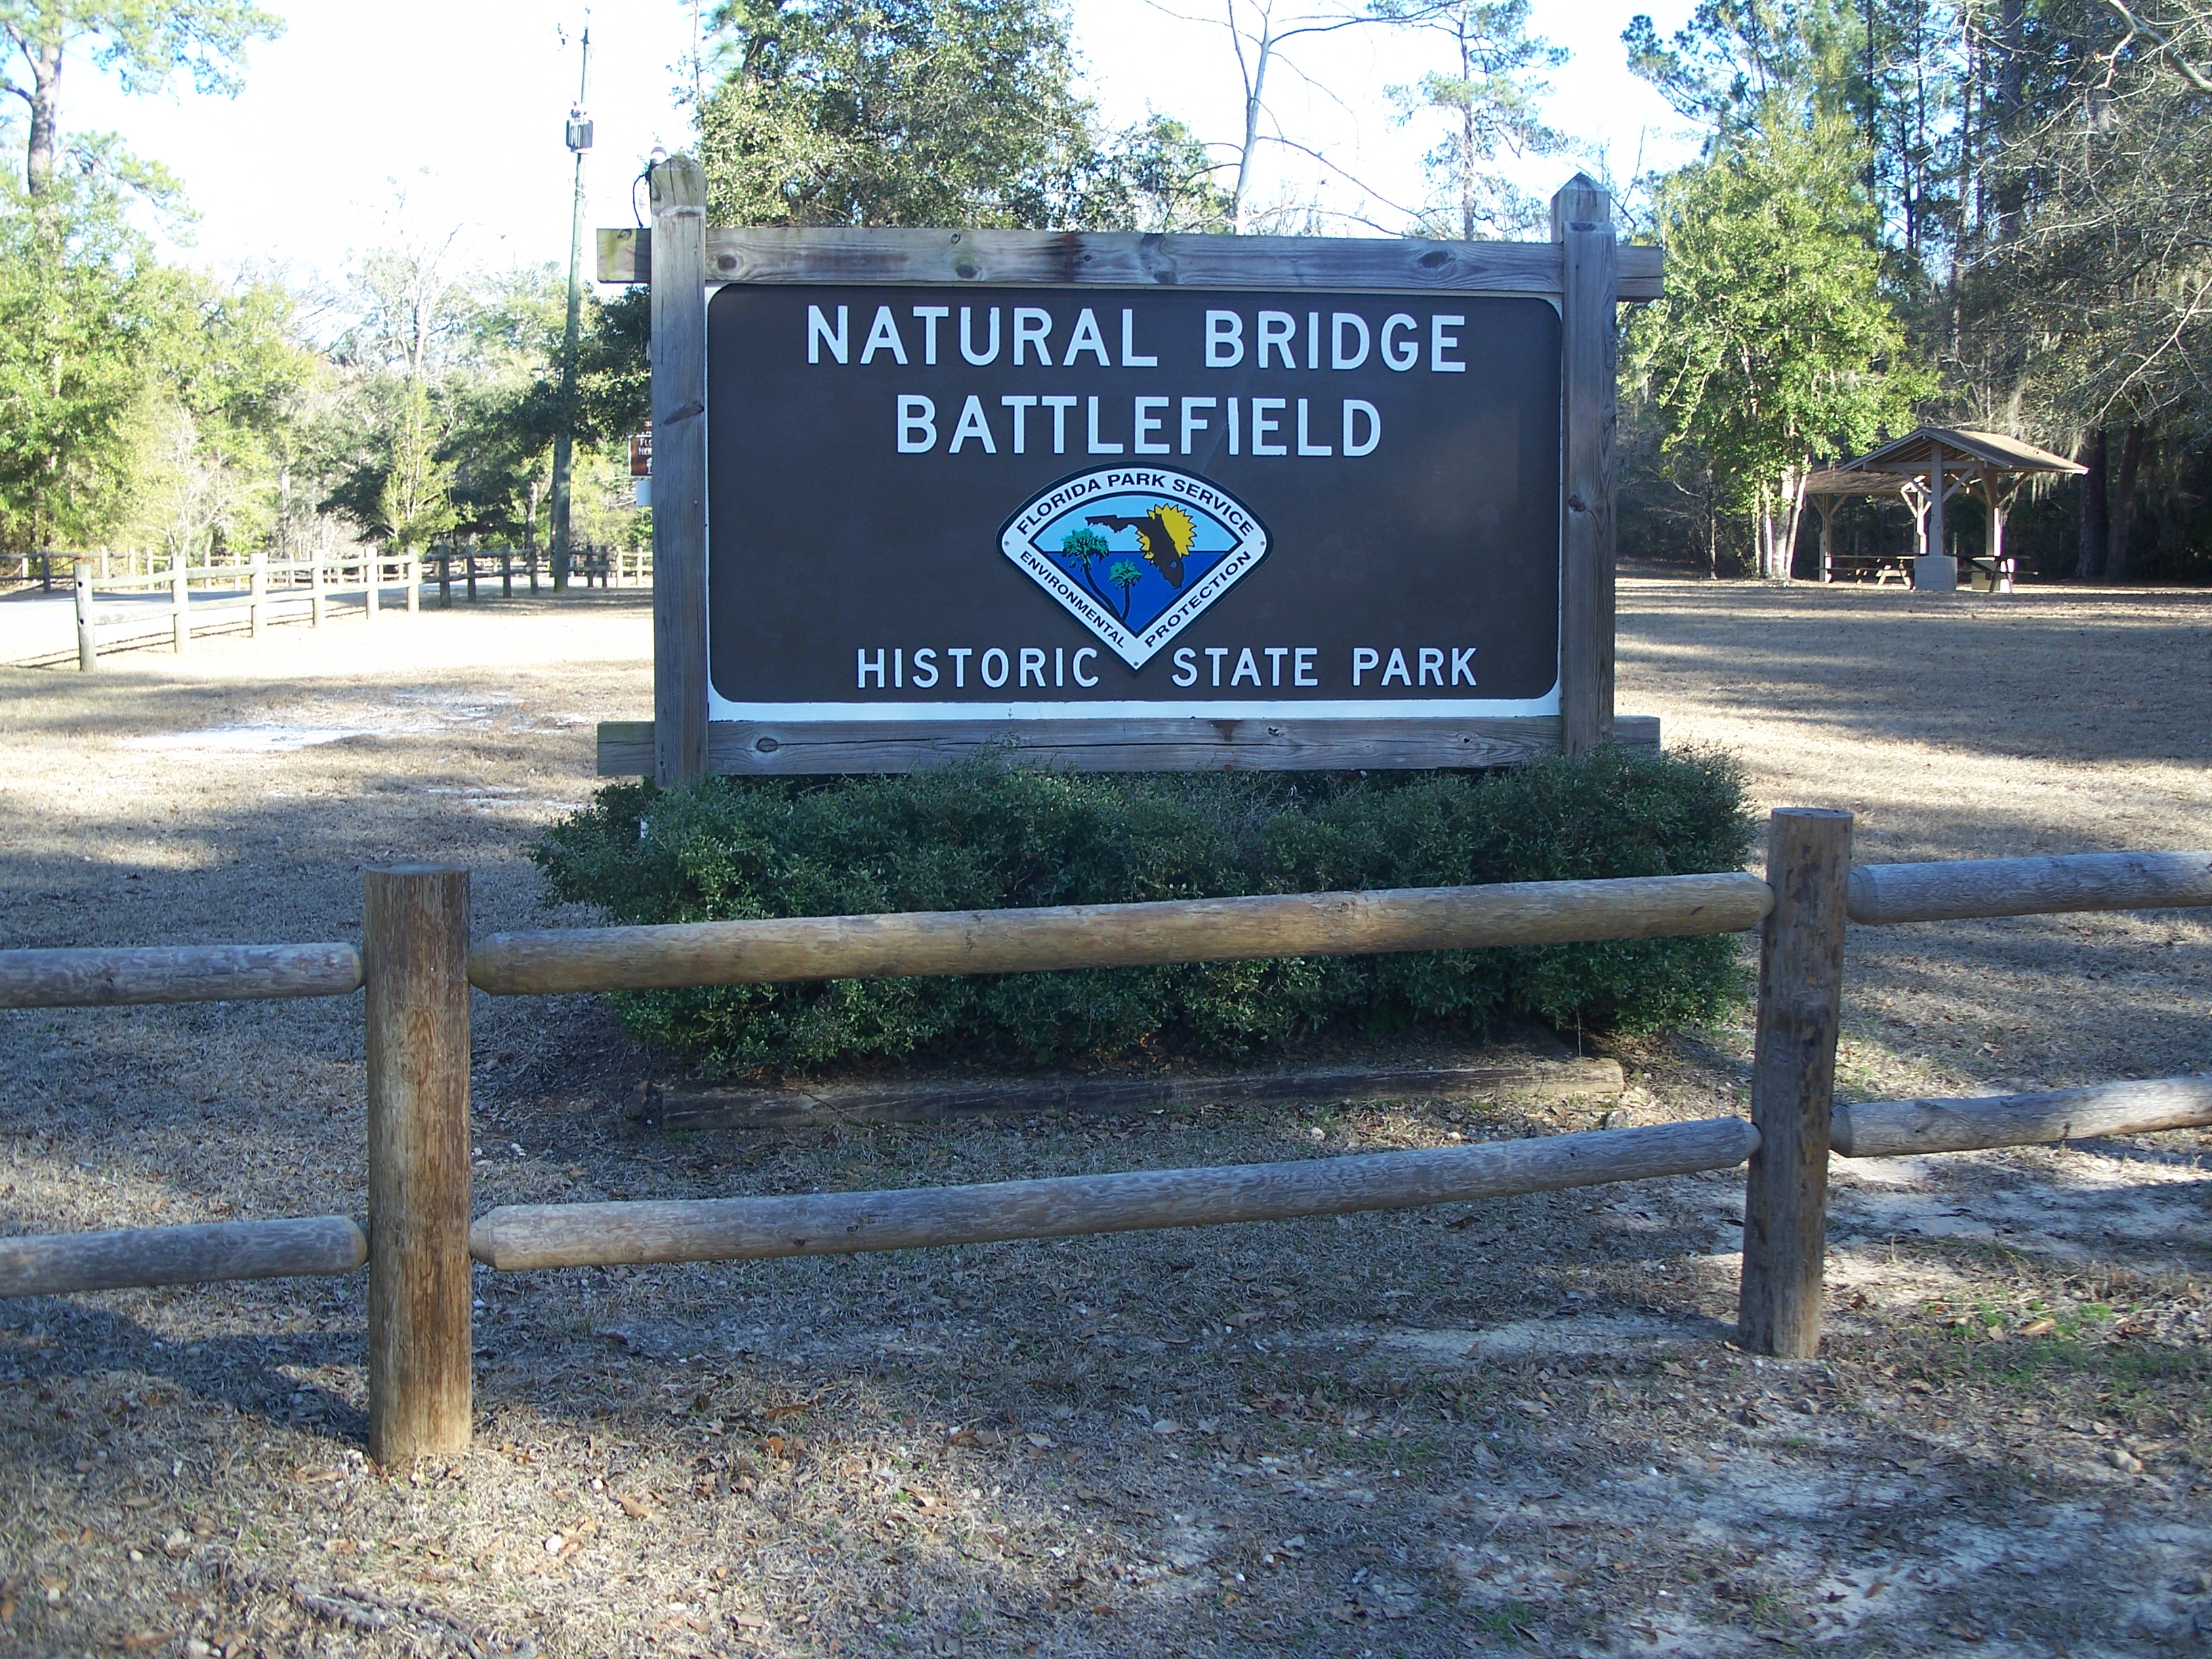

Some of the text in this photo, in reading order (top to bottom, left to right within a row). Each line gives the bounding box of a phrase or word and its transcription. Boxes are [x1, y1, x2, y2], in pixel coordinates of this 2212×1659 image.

[807, 304, 1467, 373] NATURAL BRIDGE
[897, 394, 1382, 457] BATTLEFIELD
[1016, 472, 1254, 536] FLORIDA PARK SERVICE
[1019, 550, 1125, 649] ENVIRONMENTAL
[1144, 551, 1252, 649] PROTECTION
[857, 647, 1477, 689] HISTORIC STATE PARK
